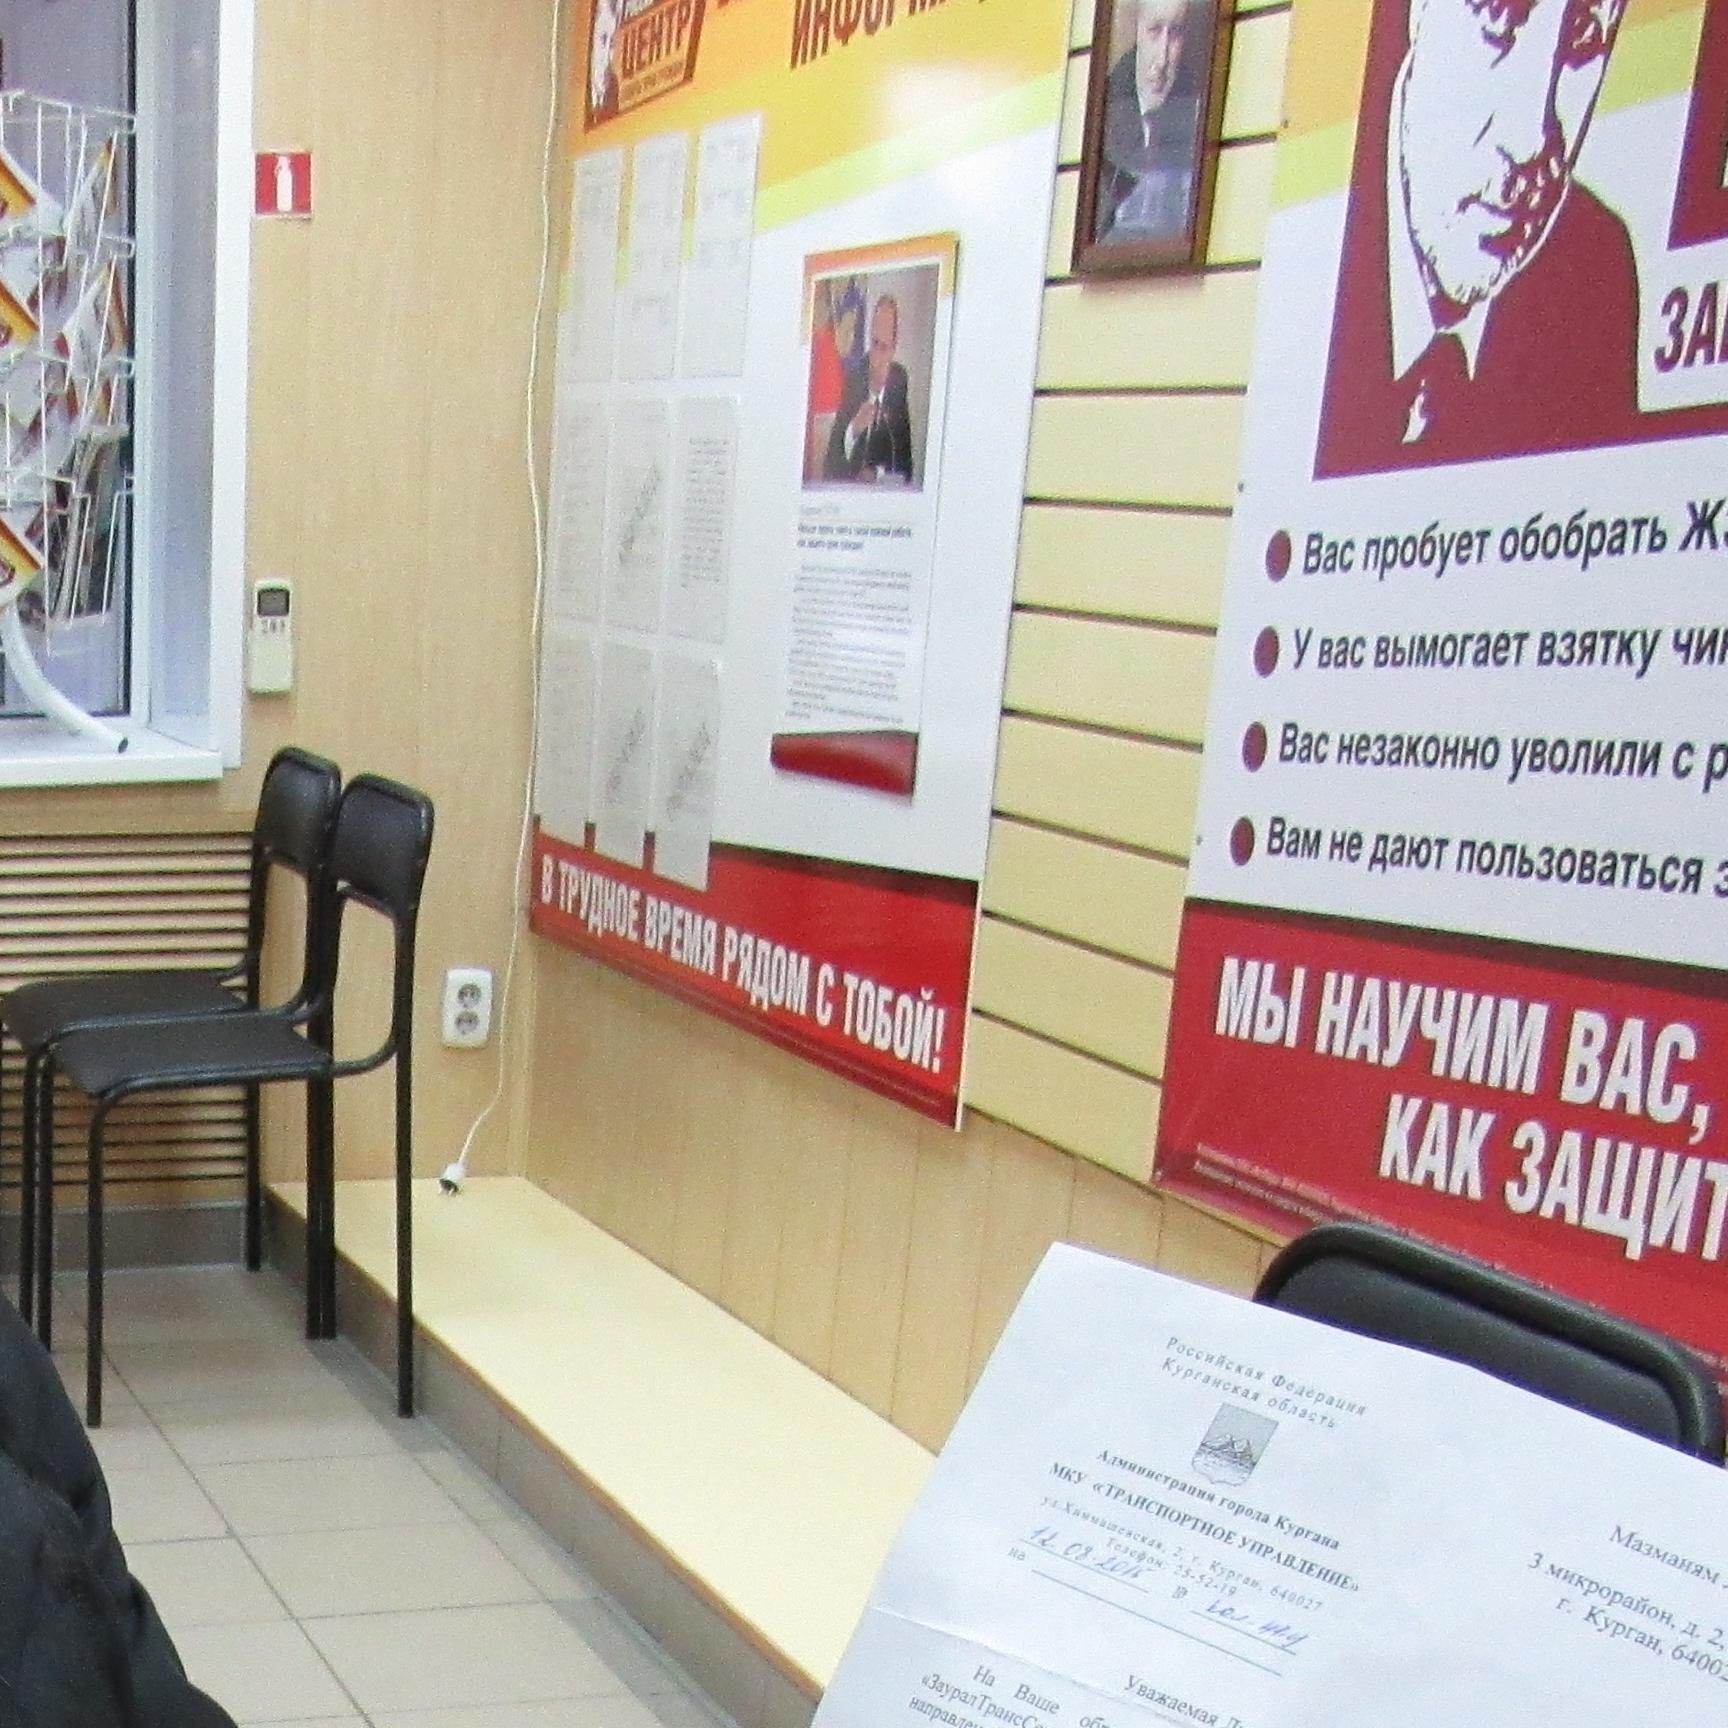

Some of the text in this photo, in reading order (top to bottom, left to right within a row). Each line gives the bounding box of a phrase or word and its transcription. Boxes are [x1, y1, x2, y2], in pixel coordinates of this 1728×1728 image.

[1654, 281, 1728, 373] ЗА
[1303, 497, 1728, 581] Вас пробует обобрать Ж
[1293, 628, 1315, 673] У
[1318, 636, 1364, 669] вас
[1374, 632, 1527, 669] вымогает
[1536, 628, 1663, 680] взятку
[1278, 722, 1330, 765] Вас
[1337, 734, 1502, 773] незаконно
[1509, 737, 1661, 784] уволили
[1673, 741, 1695, 780] с
[1267, 816, 1322, 860] Вам
[1330, 828, 1362, 864] не
[1368, 833, 1447, 874] дают
[1455, 837, 1702, 897] пользоваться
[540, 853, 946, 1074] В ТРУДНОЕ ВРЕМЯ РЯДОМ С ТОБОЙ!
[1215, 955, 1712, 1145] МЫ НАУЧИМ ВАС,
[1378, 1093, 1497, 1202] КАК
[1162, 1356, 1336, 1429] Курганская область
[1166, 1336, 1368, 1417] Российская Федерация
[1048, 1461, 1360, 1593] МКУ «ТРАНСПОРТНОЕ УПРАВЛЕНИЕ»
[1096, 1449, 1341, 1551] Администрация города Кургана
[1583, 1604, 1664, 1656] Курган,
[973, 1665, 996, 1687] На
[1014, 1682, 1061, 1716] Ваше
[1125, 1674, 1217, 1728] Уважаемая
